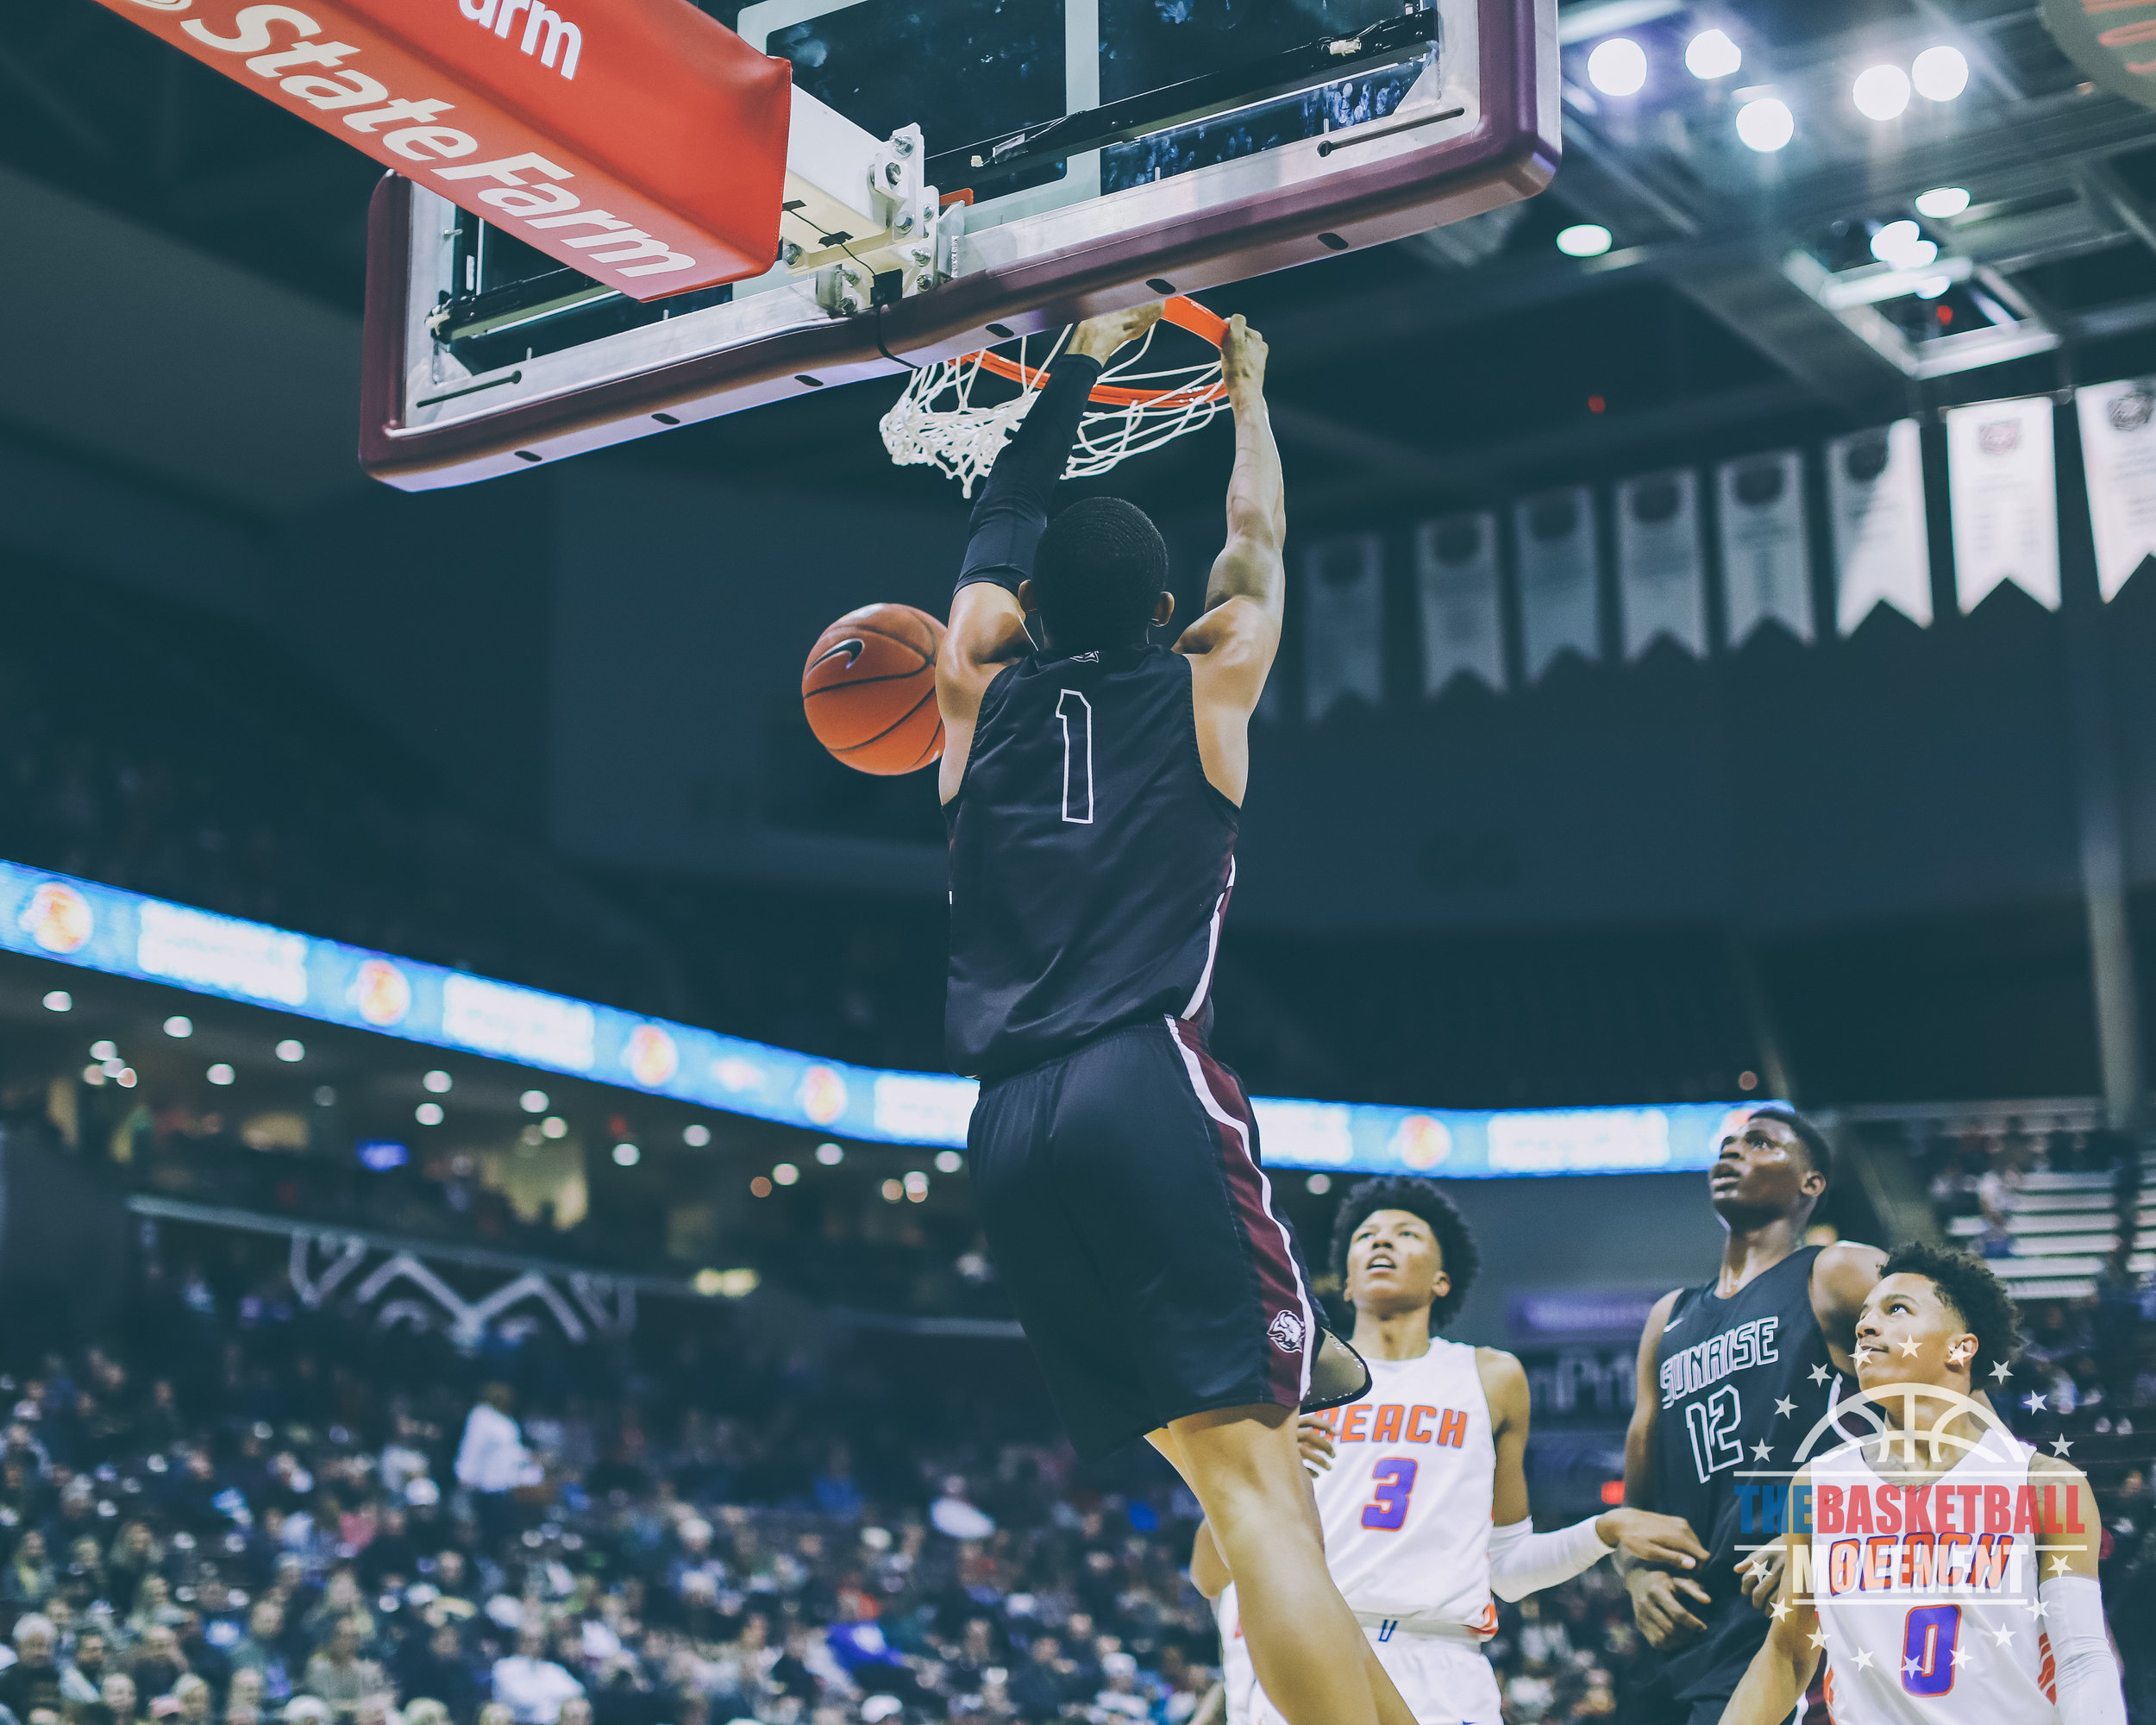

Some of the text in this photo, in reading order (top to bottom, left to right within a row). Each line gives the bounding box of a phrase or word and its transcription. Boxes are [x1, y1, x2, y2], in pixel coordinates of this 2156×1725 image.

[1056, 688, 1094, 825] 1
[1660, 1316, 1779, 1409] SUNRISE
[1685, 1383, 1745, 1484] 12
[1360, 1457, 1419, 1532] 3
[1829, 1531, 2015, 1596] BEACH
[1901, 1603, 1962, 1698] 0
